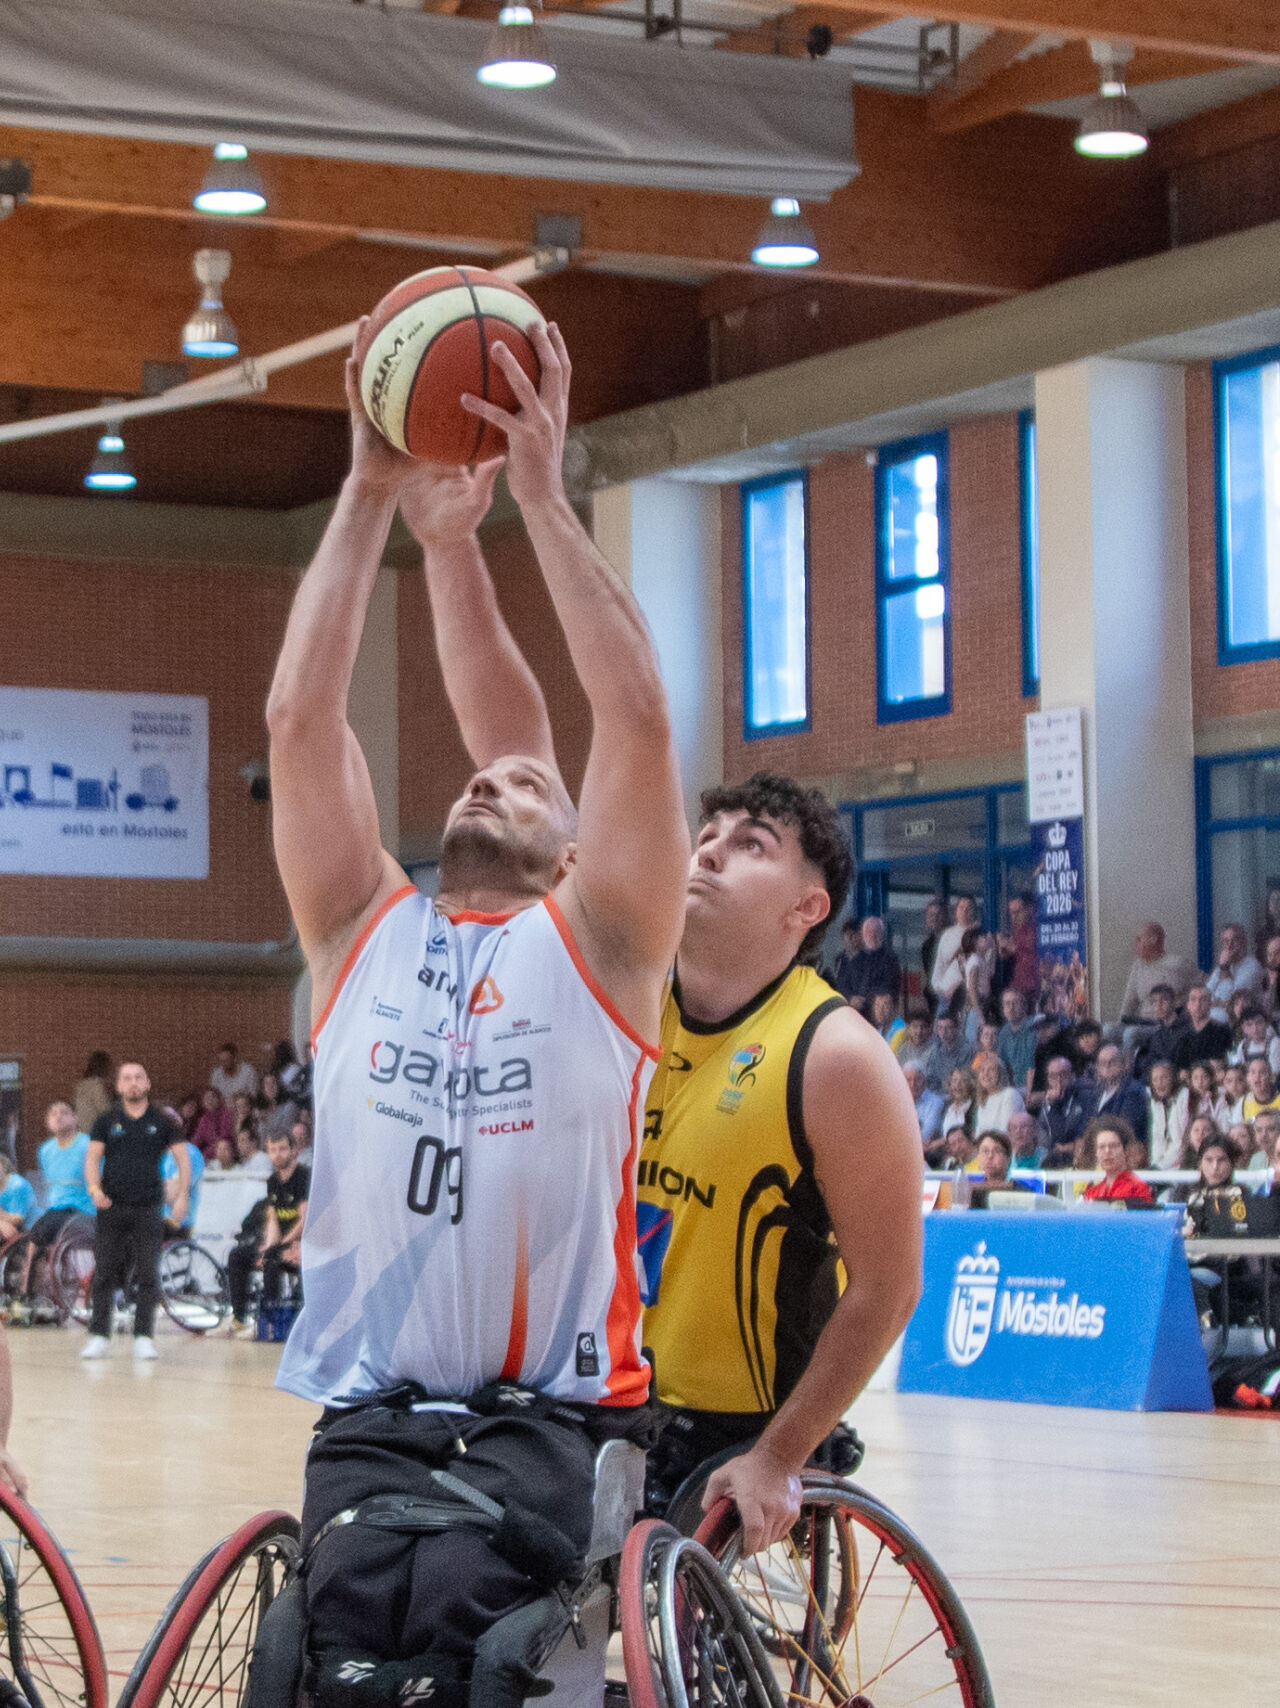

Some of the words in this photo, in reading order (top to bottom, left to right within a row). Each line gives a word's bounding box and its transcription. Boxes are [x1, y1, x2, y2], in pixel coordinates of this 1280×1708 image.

[1045, 850, 1071, 871] COPA
[1039, 873, 1057, 894] DEL
[1059, 869, 1079, 891] REY
[1046, 893, 1072, 914] 2026
[375, 1101, 424, 1128] Globalcaja
[410, 1089, 429, 1105] The
[472, 1098, 533, 1117] Specialists
[488, 1118, 535, 1136] UCLM
[406, 1134, 465, 1226] 09
[997, 1290, 1107, 1339] Móstoles
